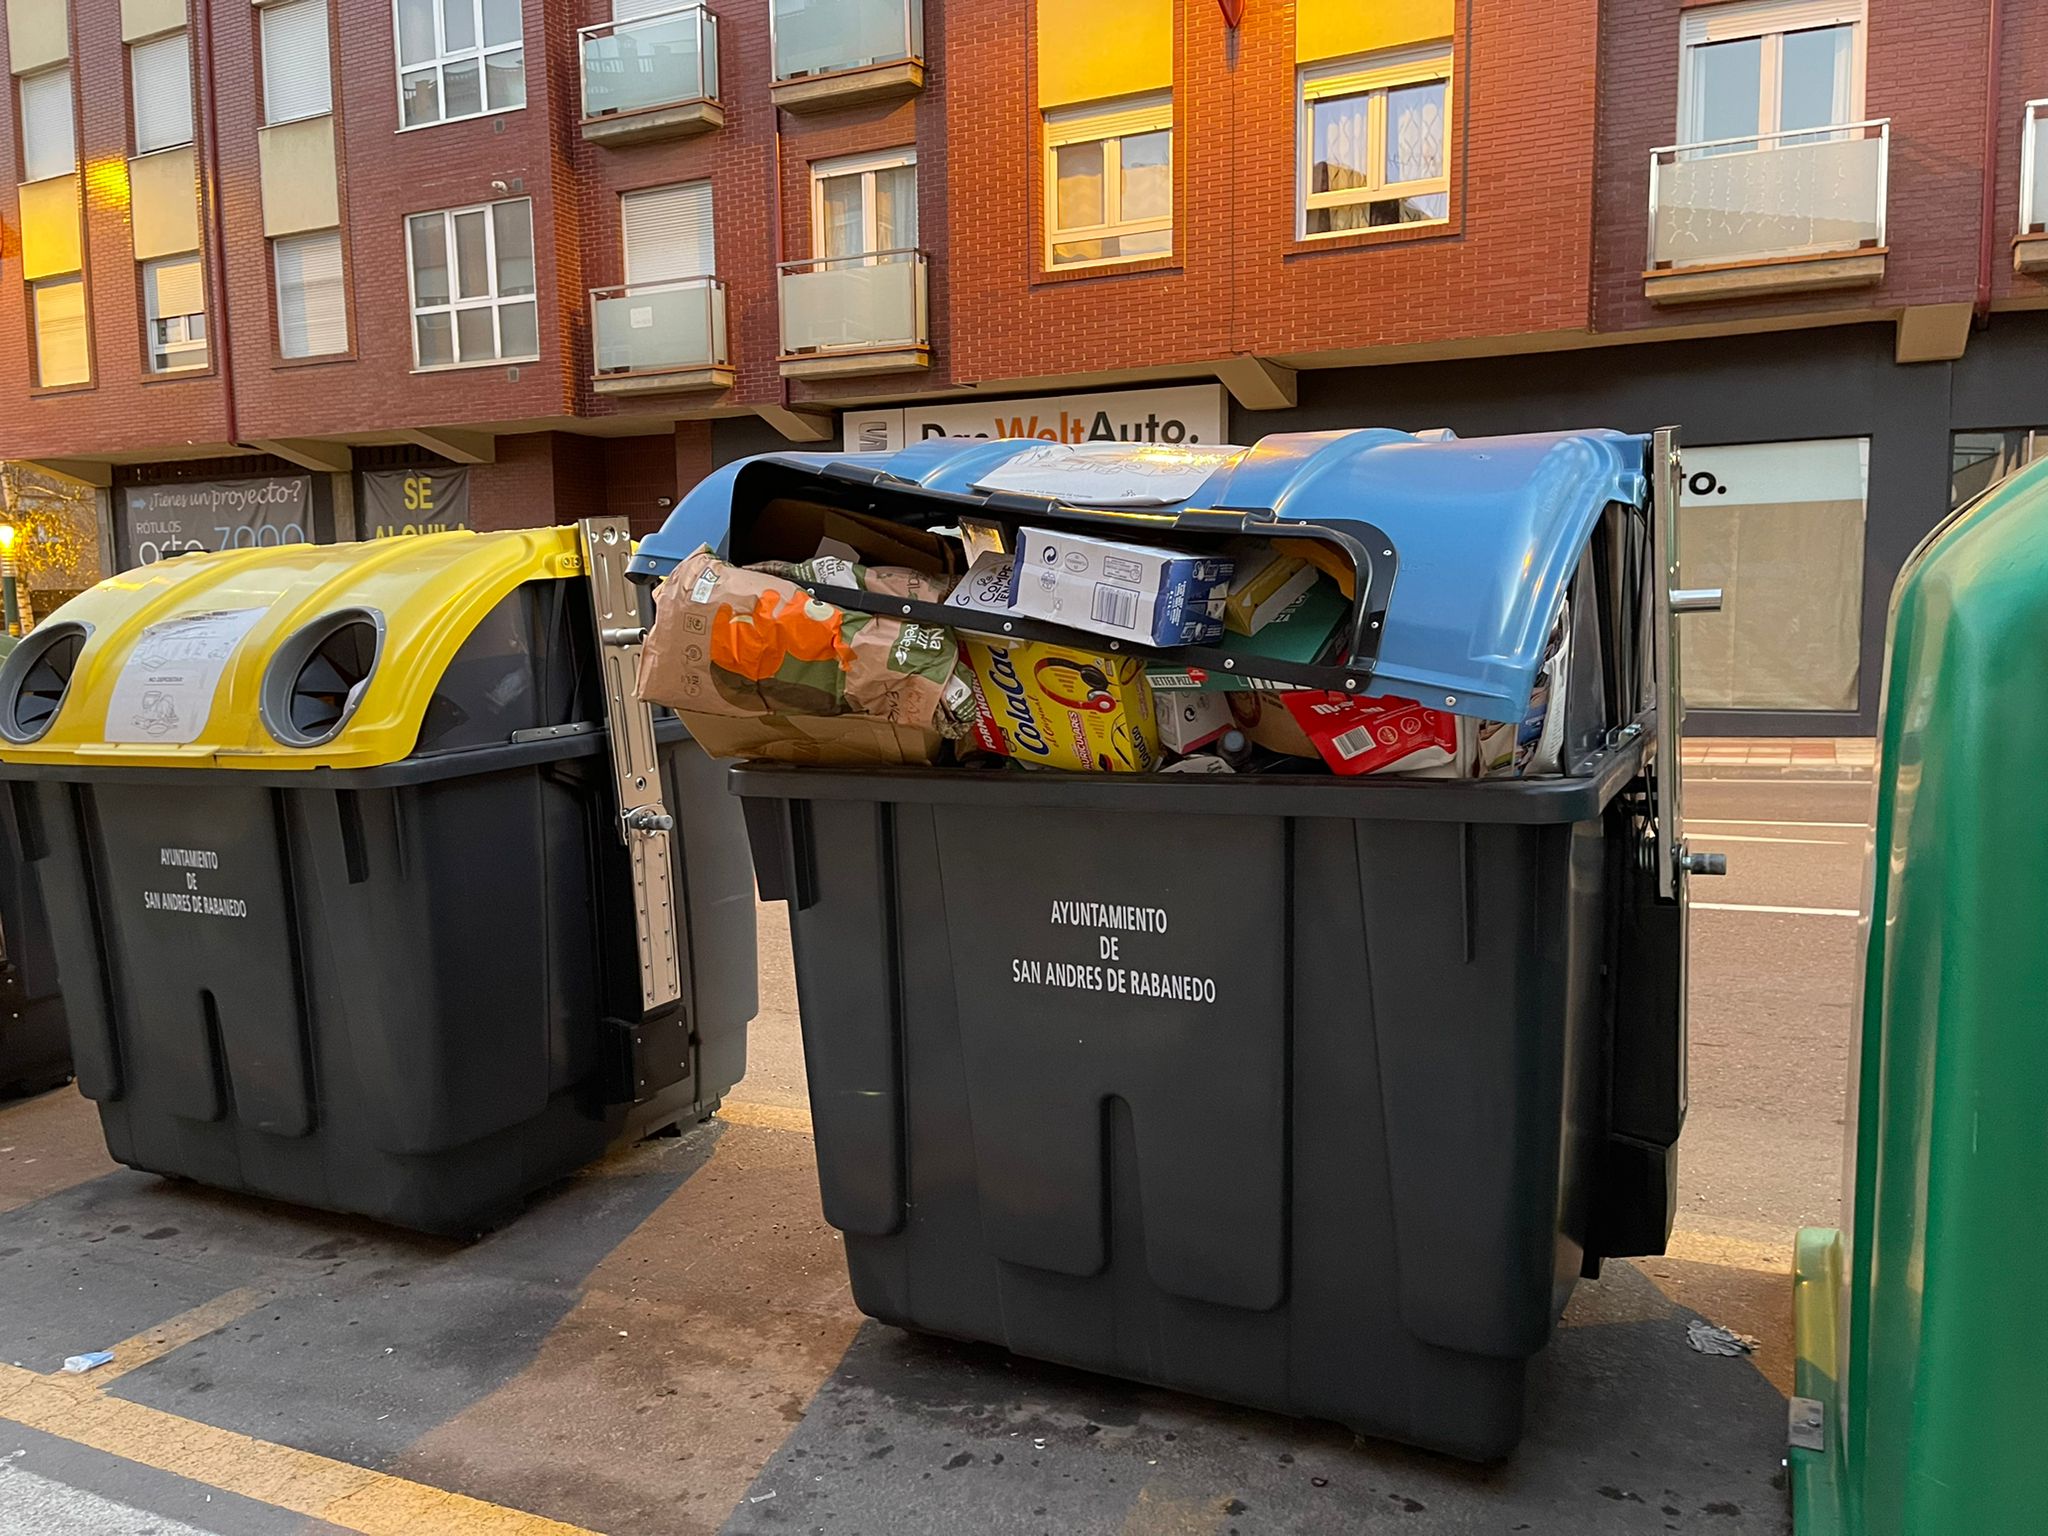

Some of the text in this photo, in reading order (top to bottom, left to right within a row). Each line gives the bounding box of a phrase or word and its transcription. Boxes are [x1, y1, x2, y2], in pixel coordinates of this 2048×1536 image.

[149, 479, 302, 512] ¿Tienes un proyecto?
[404, 477, 434, 510] SE
[898, 624, 920, 652] Pellet
[929, 628, 945, 650] Na
[1068, 710, 1093, 770] AURICULARES
[161, 848, 218, 870] AYUNTAMIENTO
[186, 872, 198, 890] DE
[144, 891, 247, 918] SAN ANDRES DE RABANEDO
[1051, 900, 1168, 934] AYUNTAMIENTO
[1100, 935, 1119, 961] DE
[1012, 958, 1216, 1003] SAN ANDRES DE RABANEDO
